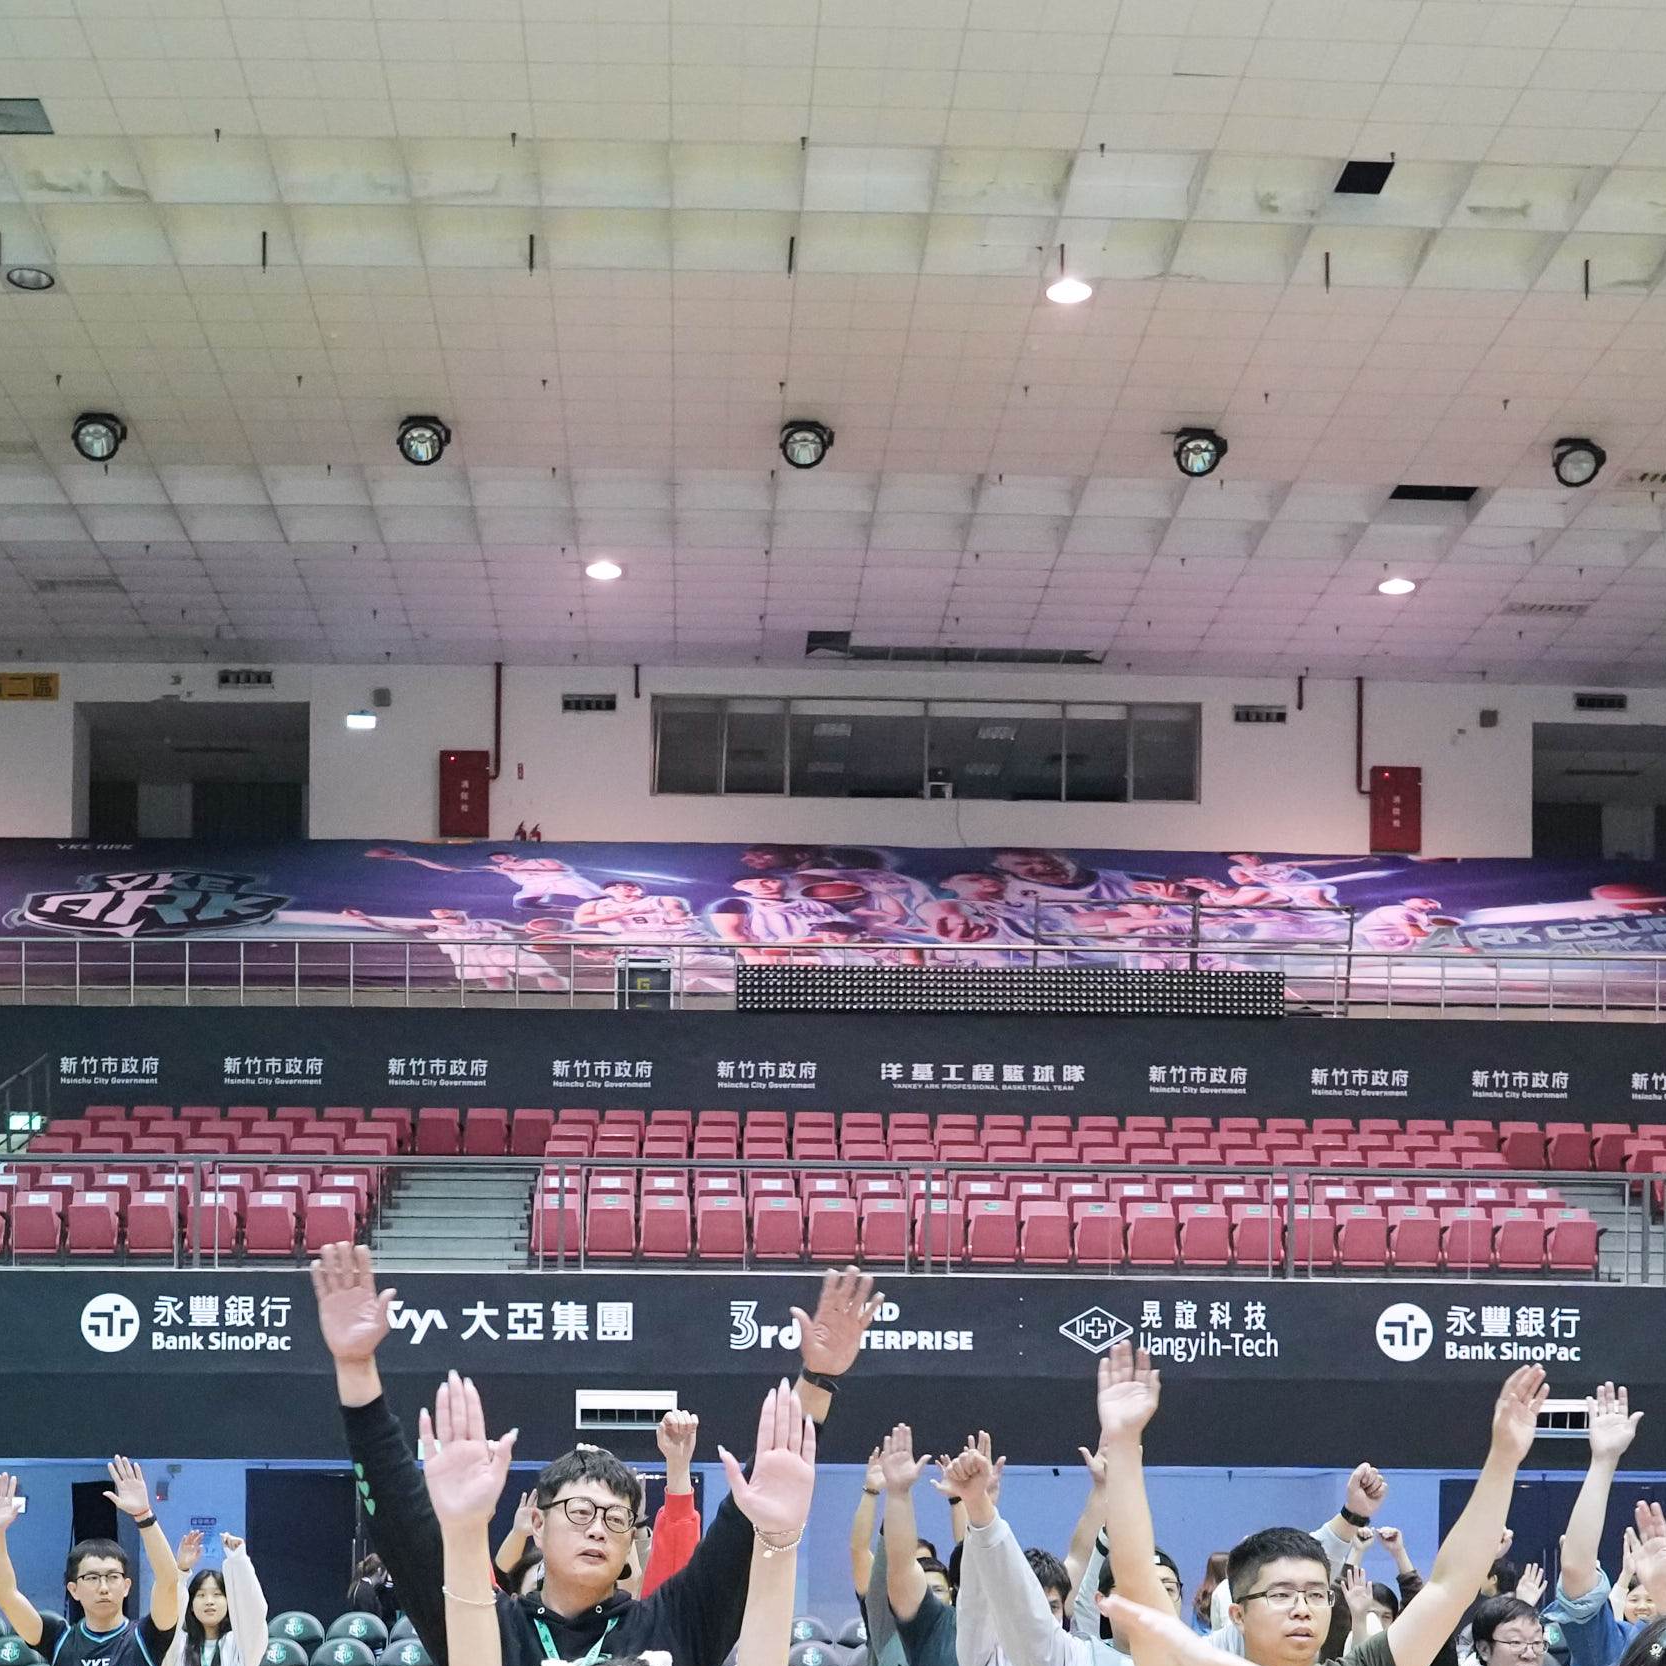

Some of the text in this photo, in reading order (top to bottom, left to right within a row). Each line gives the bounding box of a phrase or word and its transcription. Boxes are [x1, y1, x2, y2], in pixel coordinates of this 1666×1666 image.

[103, 872, 242, 893] YKE
[59, 1055, 160, 1075] 新竹市政府
[223, 1056, 324, 1075] 新竹市政府
[387, 1057, 489, 1077] 新竹市政府
[552, 1059, 653, 1079] 新竹市政府
[716, 1060, 817, 1080] 新竹市政府
[880, 1062, 1085, 1083] 洋基工程籃球隊
[1148, 1064, 1248, 1085] 新竹市政府
[93, 1076, 110, 1085] City
[110, 1076, 158, 1085] Government
[257, 1076, 273, 1086] City
[274, 1076, 322, 1085] Government
[421, 1078, 438, 1087] City
[438, 1078, 487, 1087] Government
[585, 1079, 602, 1089] City
[603, 1079, 652, 1088] Government
[750, 1081, 767, 1090] City
[767, 1081, 816, 1089] Government
[1310, 1067, 1409, 1087] 新竹市政府
[1471, 1069, 1569, 1090] 新竹市政府
[1052, 1084, 1075, 1092] TEAM
[1182, 1085, 1198, 1094] City
[1199, 1086, 1247, 1095] Government
[1343, 1088, 1360, 1097] City
[1360, 1088, 1408, 1097] Government
[1504, 1090, 1521, 1099] City
[1521, 1090, 1568, 1099] Government
[152, 1294, 292, 1328] 永豐銀行
[460, 1300, 634, 1342] 大亞集團
[1140, 1299, 1267, 1331] 晃誼科技
[729, 1300, 803, 1351] 3rd
[1445, 1305, 1581, 1339] 永豐銀行
[151, 1330, 292, 1351] Bank SinoPac
[859, 1330, 974, 1352] TERPRISE
[1140, 1330, 1279, 1361] Uangyih-Tech
[1444, 1341, 1581, 1362] Bank SinoPac
